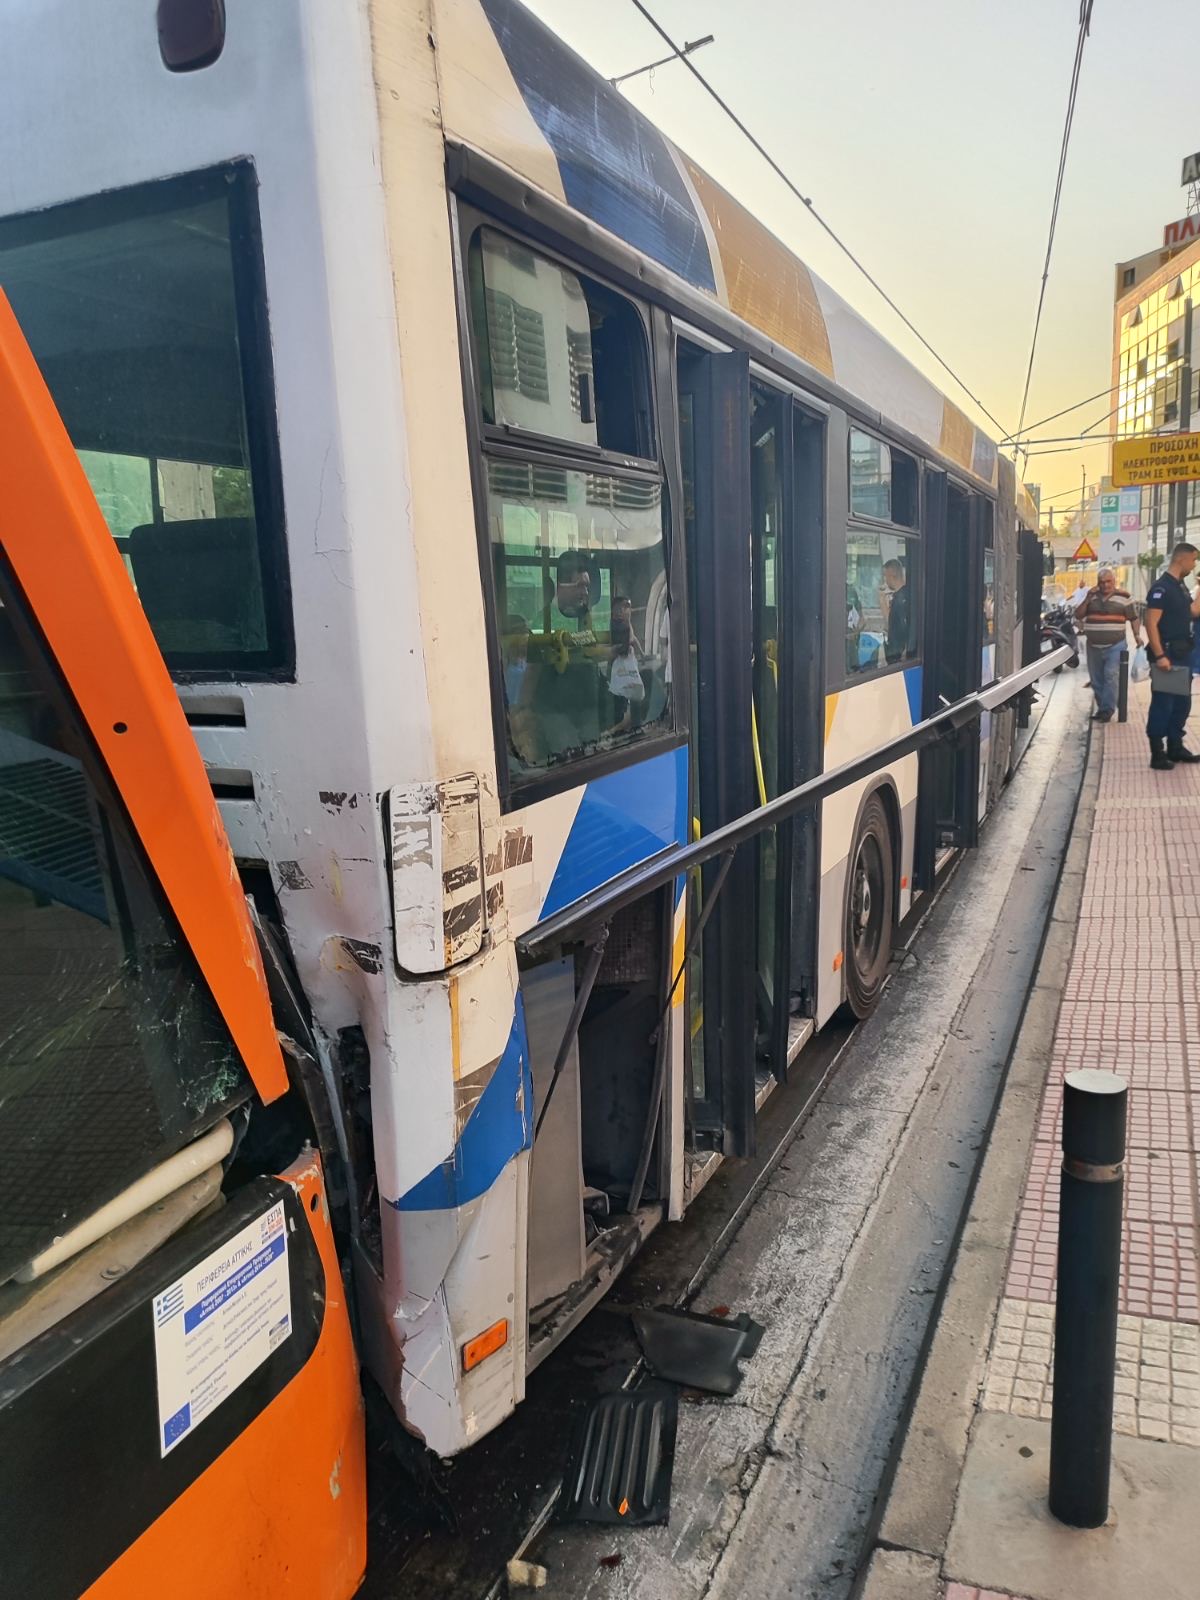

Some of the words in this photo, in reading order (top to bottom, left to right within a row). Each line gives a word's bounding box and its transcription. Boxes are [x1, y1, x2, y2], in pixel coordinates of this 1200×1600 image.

[1165, 216, 1200, 246] ΠΛ
[1150, 439, 1198, 454] ΠΡΟΣΟΧΗ
[1123, 454, 1185, 469] ΗΛΕΚΤΡΟΦΟΡΑ
[1129, 470, 1151, 481] ΤΡΑΜ
[1154, 468, 1163, 478] ΣΕ
[1102, 496, 1117, 508] E2
[1121, 515, 1137, 527] E9
[197, 1258, 230, 1293] ΠΕΡΙΦΕΡΕΙΑ
[231, 1240, 253, 1265] ΑΤΤΙΚΗΣ
